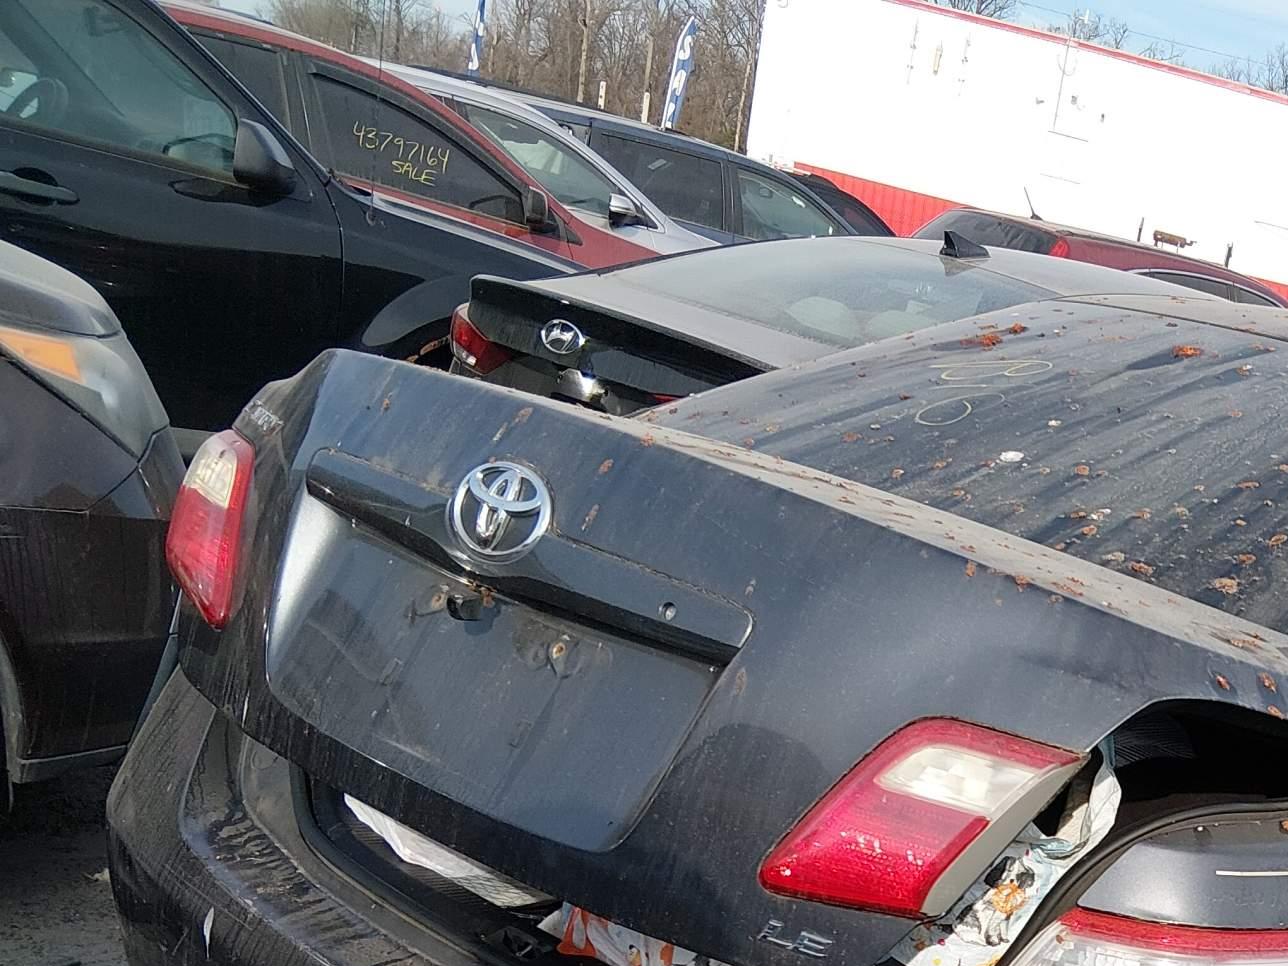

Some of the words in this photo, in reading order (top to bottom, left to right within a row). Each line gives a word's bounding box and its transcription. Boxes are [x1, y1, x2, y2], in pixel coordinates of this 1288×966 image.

[353, 121, 450, 174] 43797164
[391, 161, 438, 187] SALE
[756, 919, 833, 957] LE
